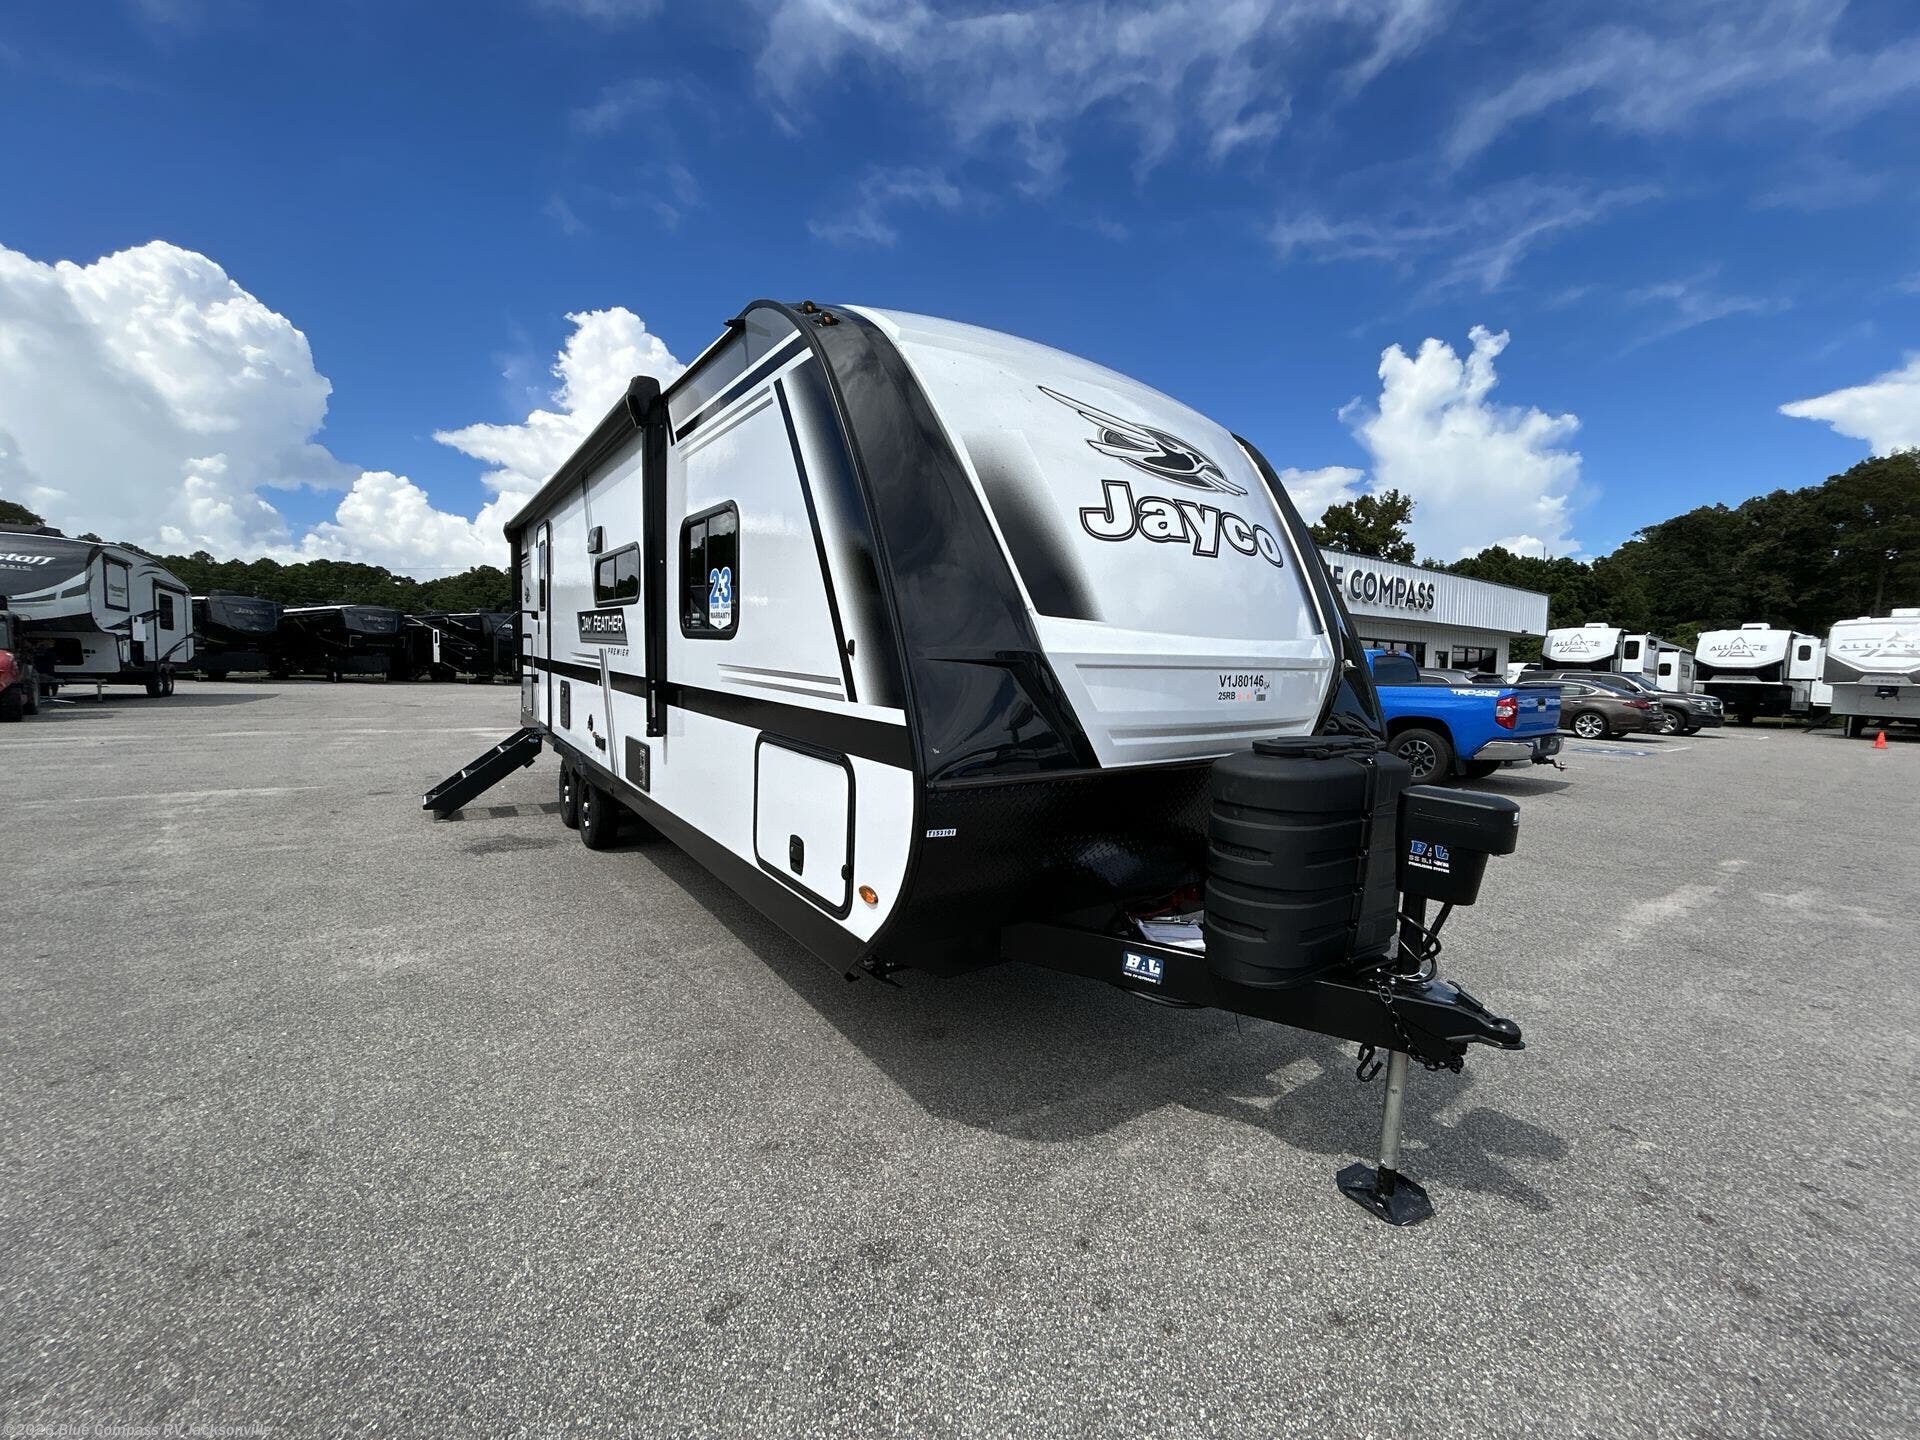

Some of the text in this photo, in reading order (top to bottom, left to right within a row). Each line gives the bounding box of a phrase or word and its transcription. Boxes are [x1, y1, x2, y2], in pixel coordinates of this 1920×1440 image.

[1079, 479, 1284, 568] Jayco
[1349, 569, 1435, 610] COMPASS
[581, 615, 623, 631] JAY FEATHER
[1219, 674, 1264, 688] V1J80146
[1218, 691, 1236, 701] 25RB
[1411, 840, 1450, 860] BAL
[1126, 953, 1161, 975] BAL
